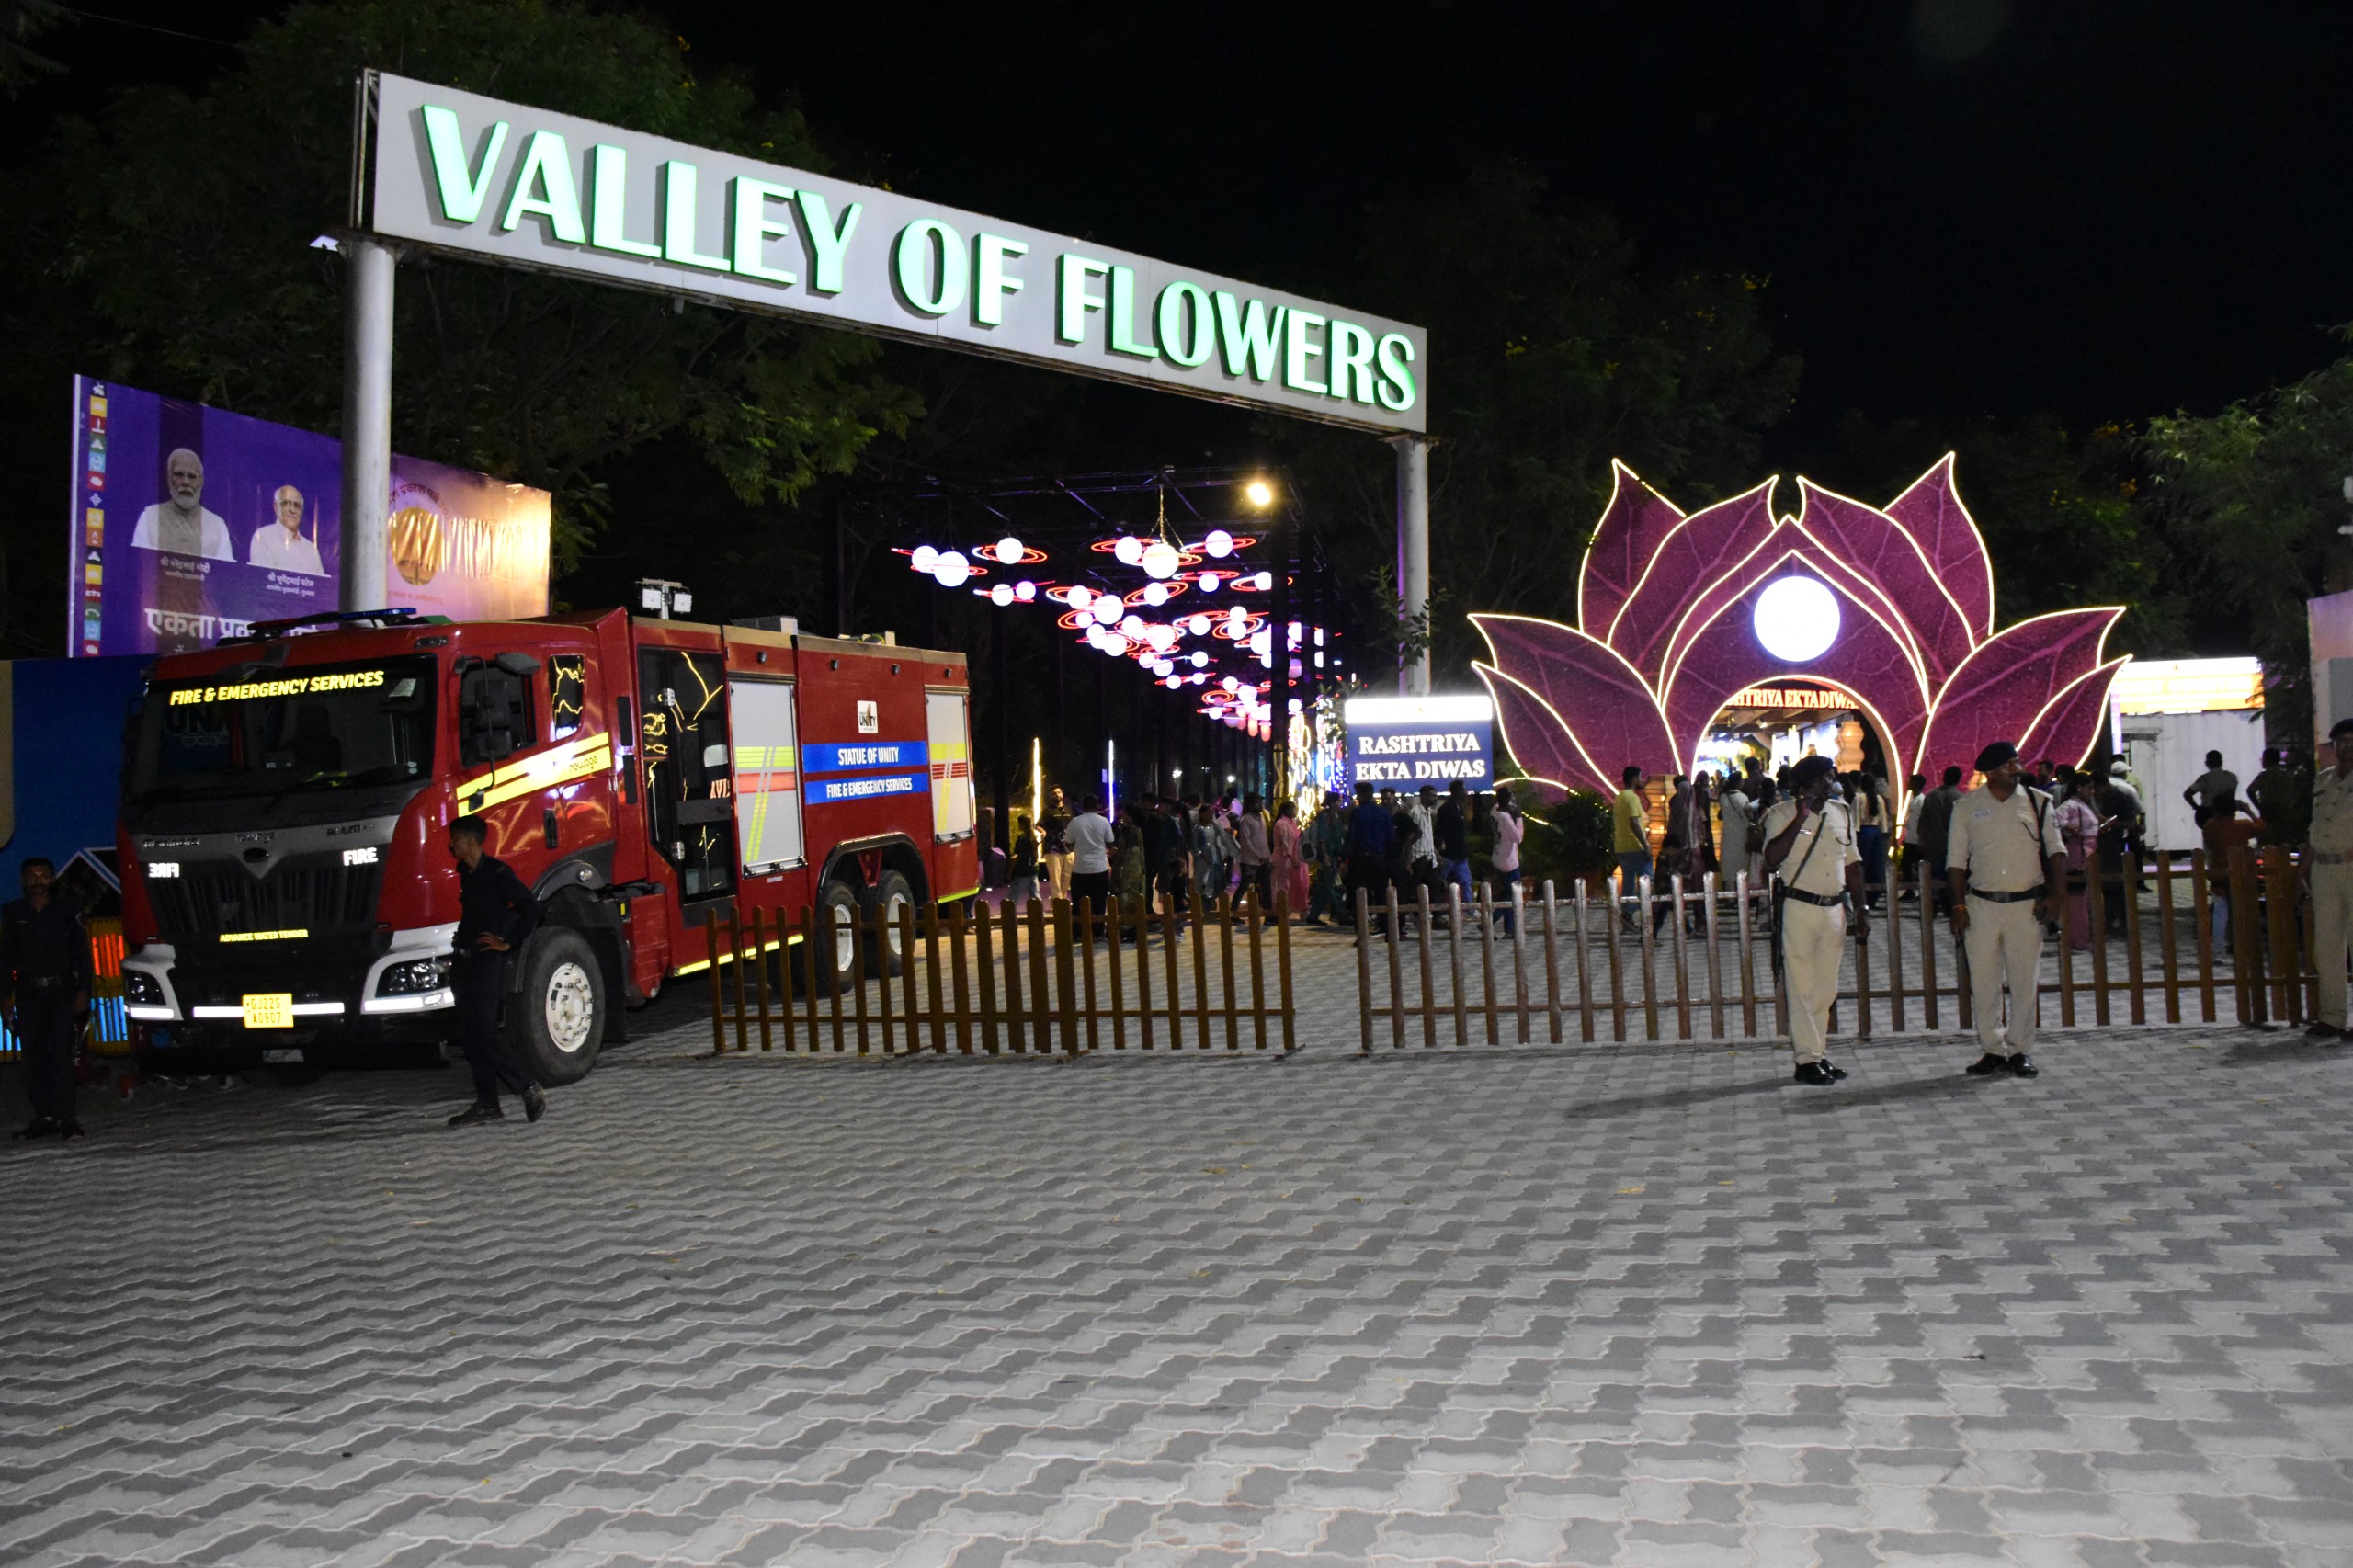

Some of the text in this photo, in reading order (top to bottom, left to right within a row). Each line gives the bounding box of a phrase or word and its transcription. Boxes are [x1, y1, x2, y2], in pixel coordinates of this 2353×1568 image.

[422, 105, 1416, 412] VALLEY OF FLOWERS
[144, 608, 216, 640] एकता
[170, 671, 384, 706] FIRE & EMERGENCY SERVICES
[1358, 733, 1481, 755] RASHTRIYA
[838, 747, 899, 766] STATUE OF UNITY
[1355, 759, 1486, 781] EKTA DIWAS
[826, 778, 913, 799] FIRE & EMERGENCY SERVICES
[343, 847, 378, 866] FIRE
[220, 929, 309, 942] ADVANCE WATER TENDER
[251, 997, 281, 1010] GJ22G
[253, 1012, 281, 1023] A0907
